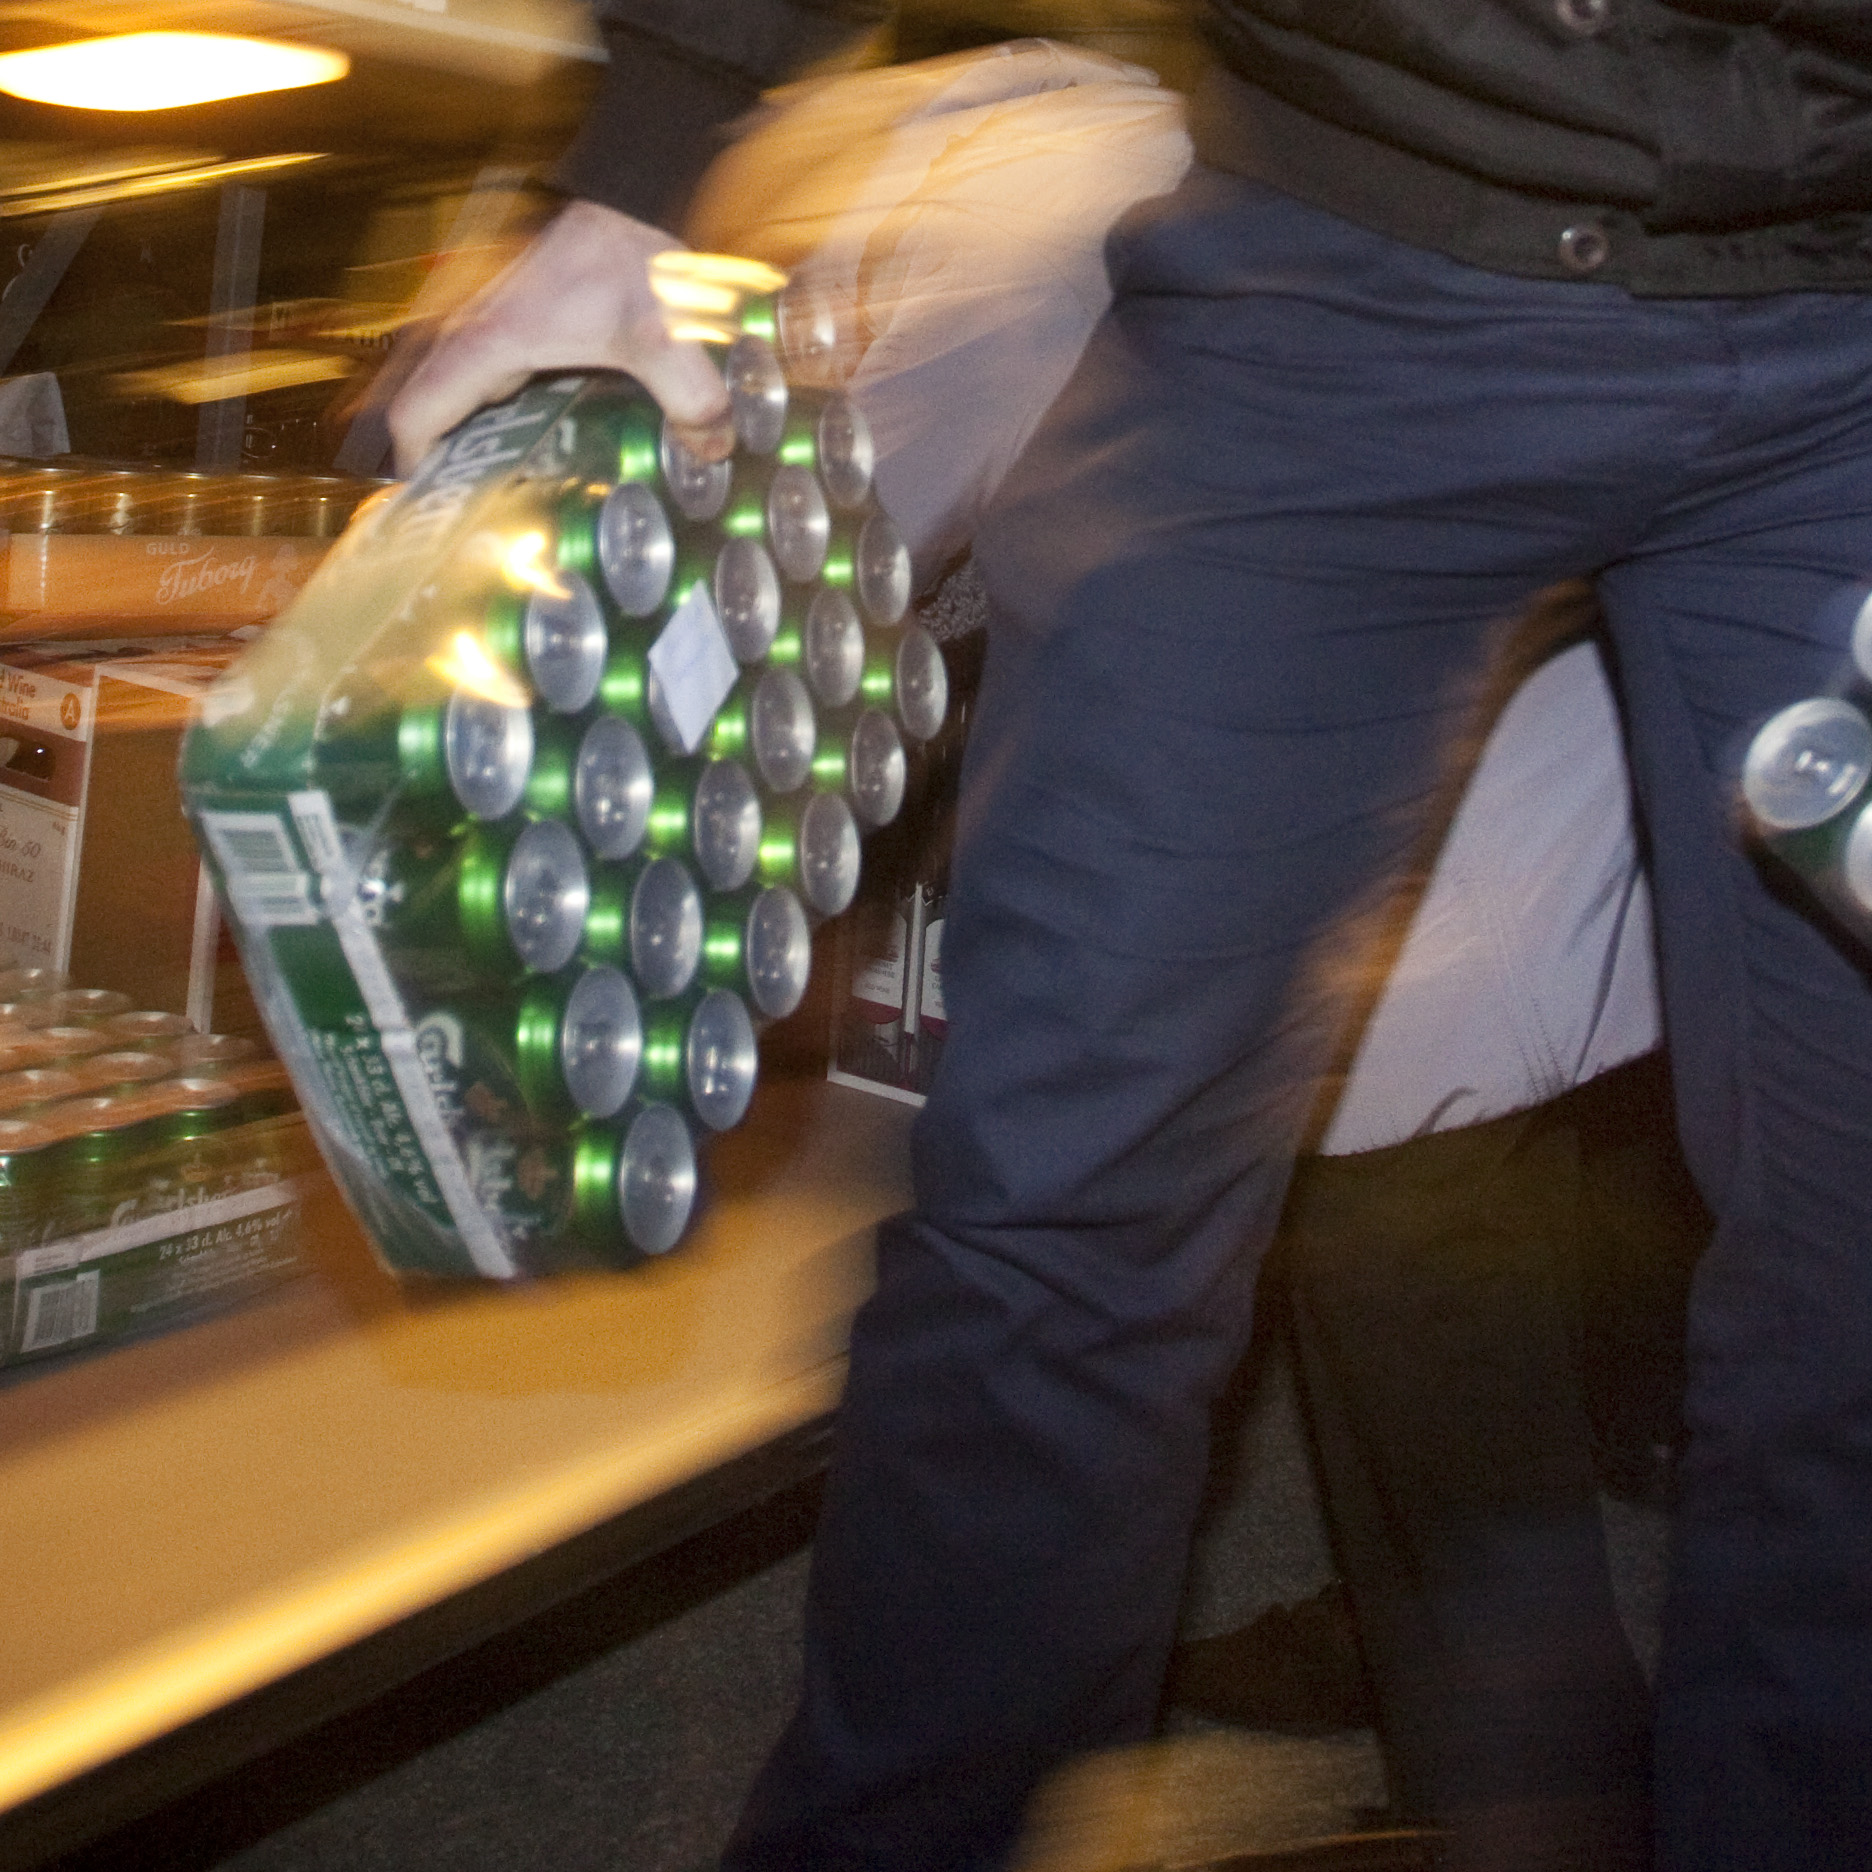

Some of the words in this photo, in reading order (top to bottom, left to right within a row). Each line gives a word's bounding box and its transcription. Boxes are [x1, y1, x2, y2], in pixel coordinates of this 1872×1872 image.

[146, 542, 190, 556] GULD
[155, 547, 257, 605] Tuborg
[6, 669, 37, 700] Wine
